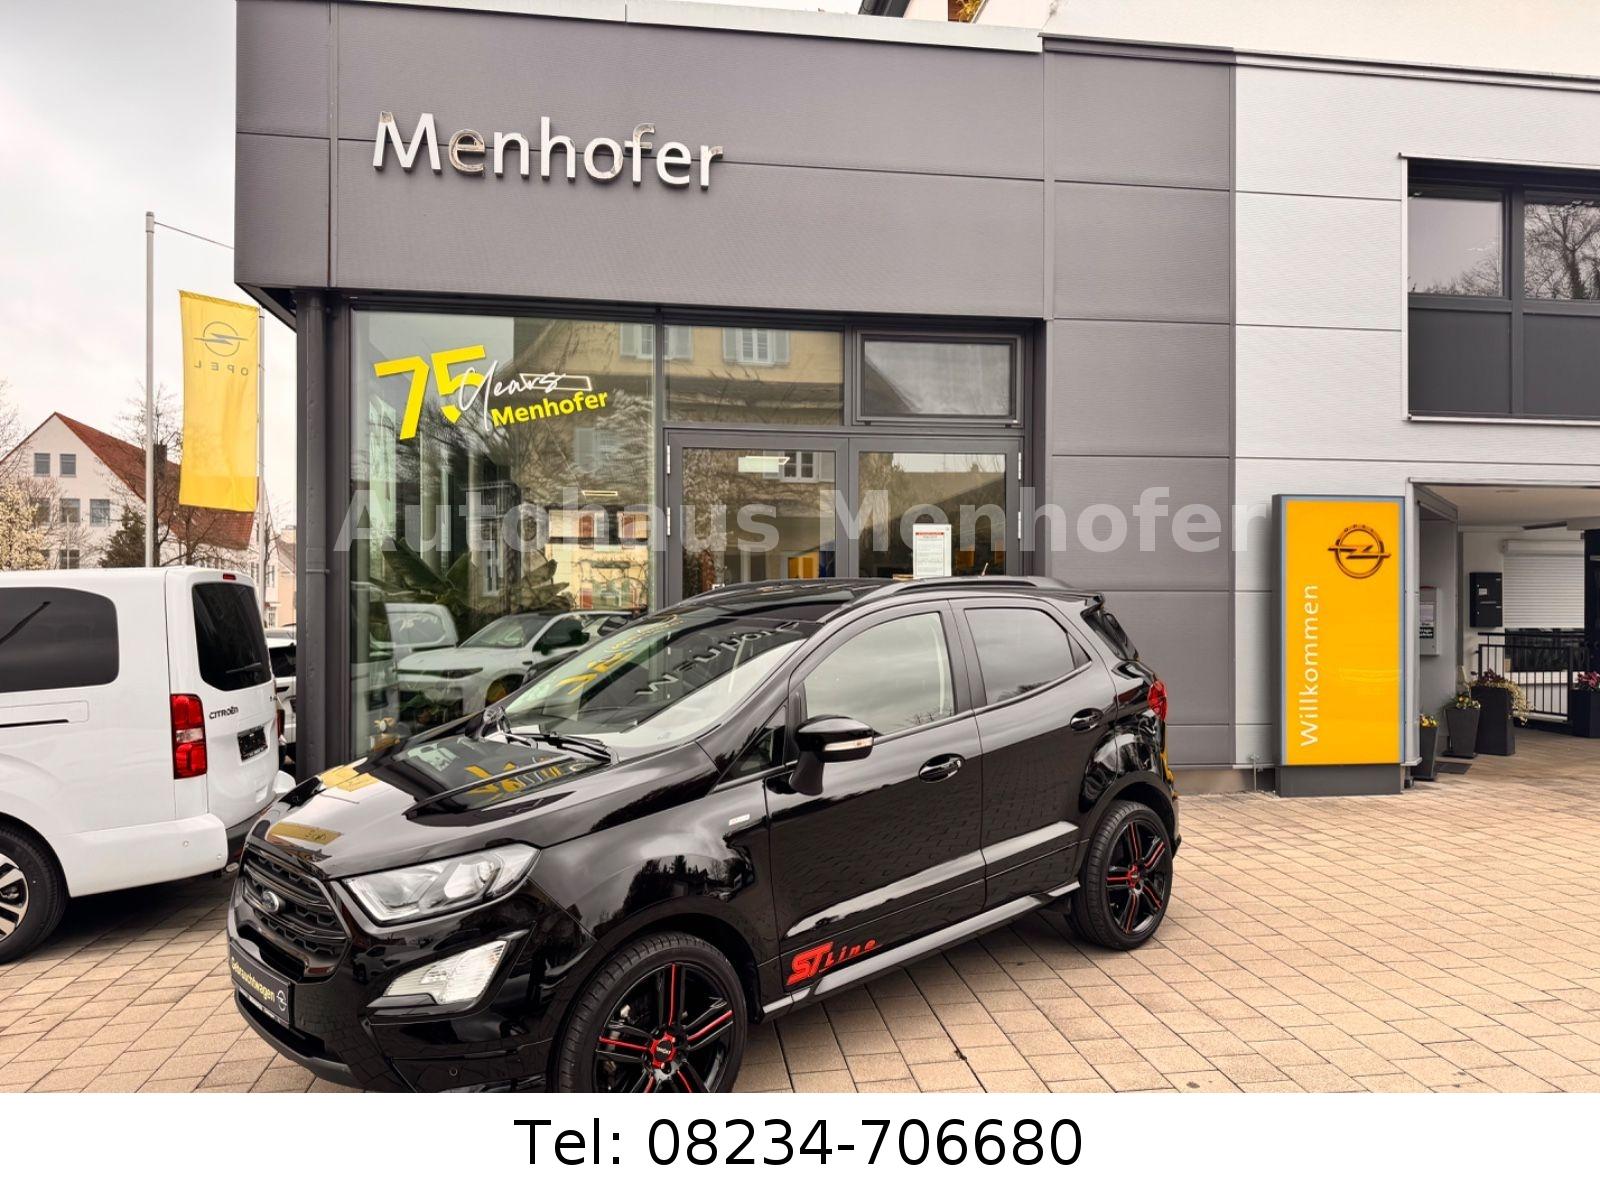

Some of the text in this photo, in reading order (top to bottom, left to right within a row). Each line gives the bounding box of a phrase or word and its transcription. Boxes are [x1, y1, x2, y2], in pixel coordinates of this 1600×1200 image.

[373, 111, 723, 190] Menhofer
[374, 344, 486, 440] 75
[491, 391, 609, 427] Menhofer
[1299, 584, 1319, 747] Willkommen
